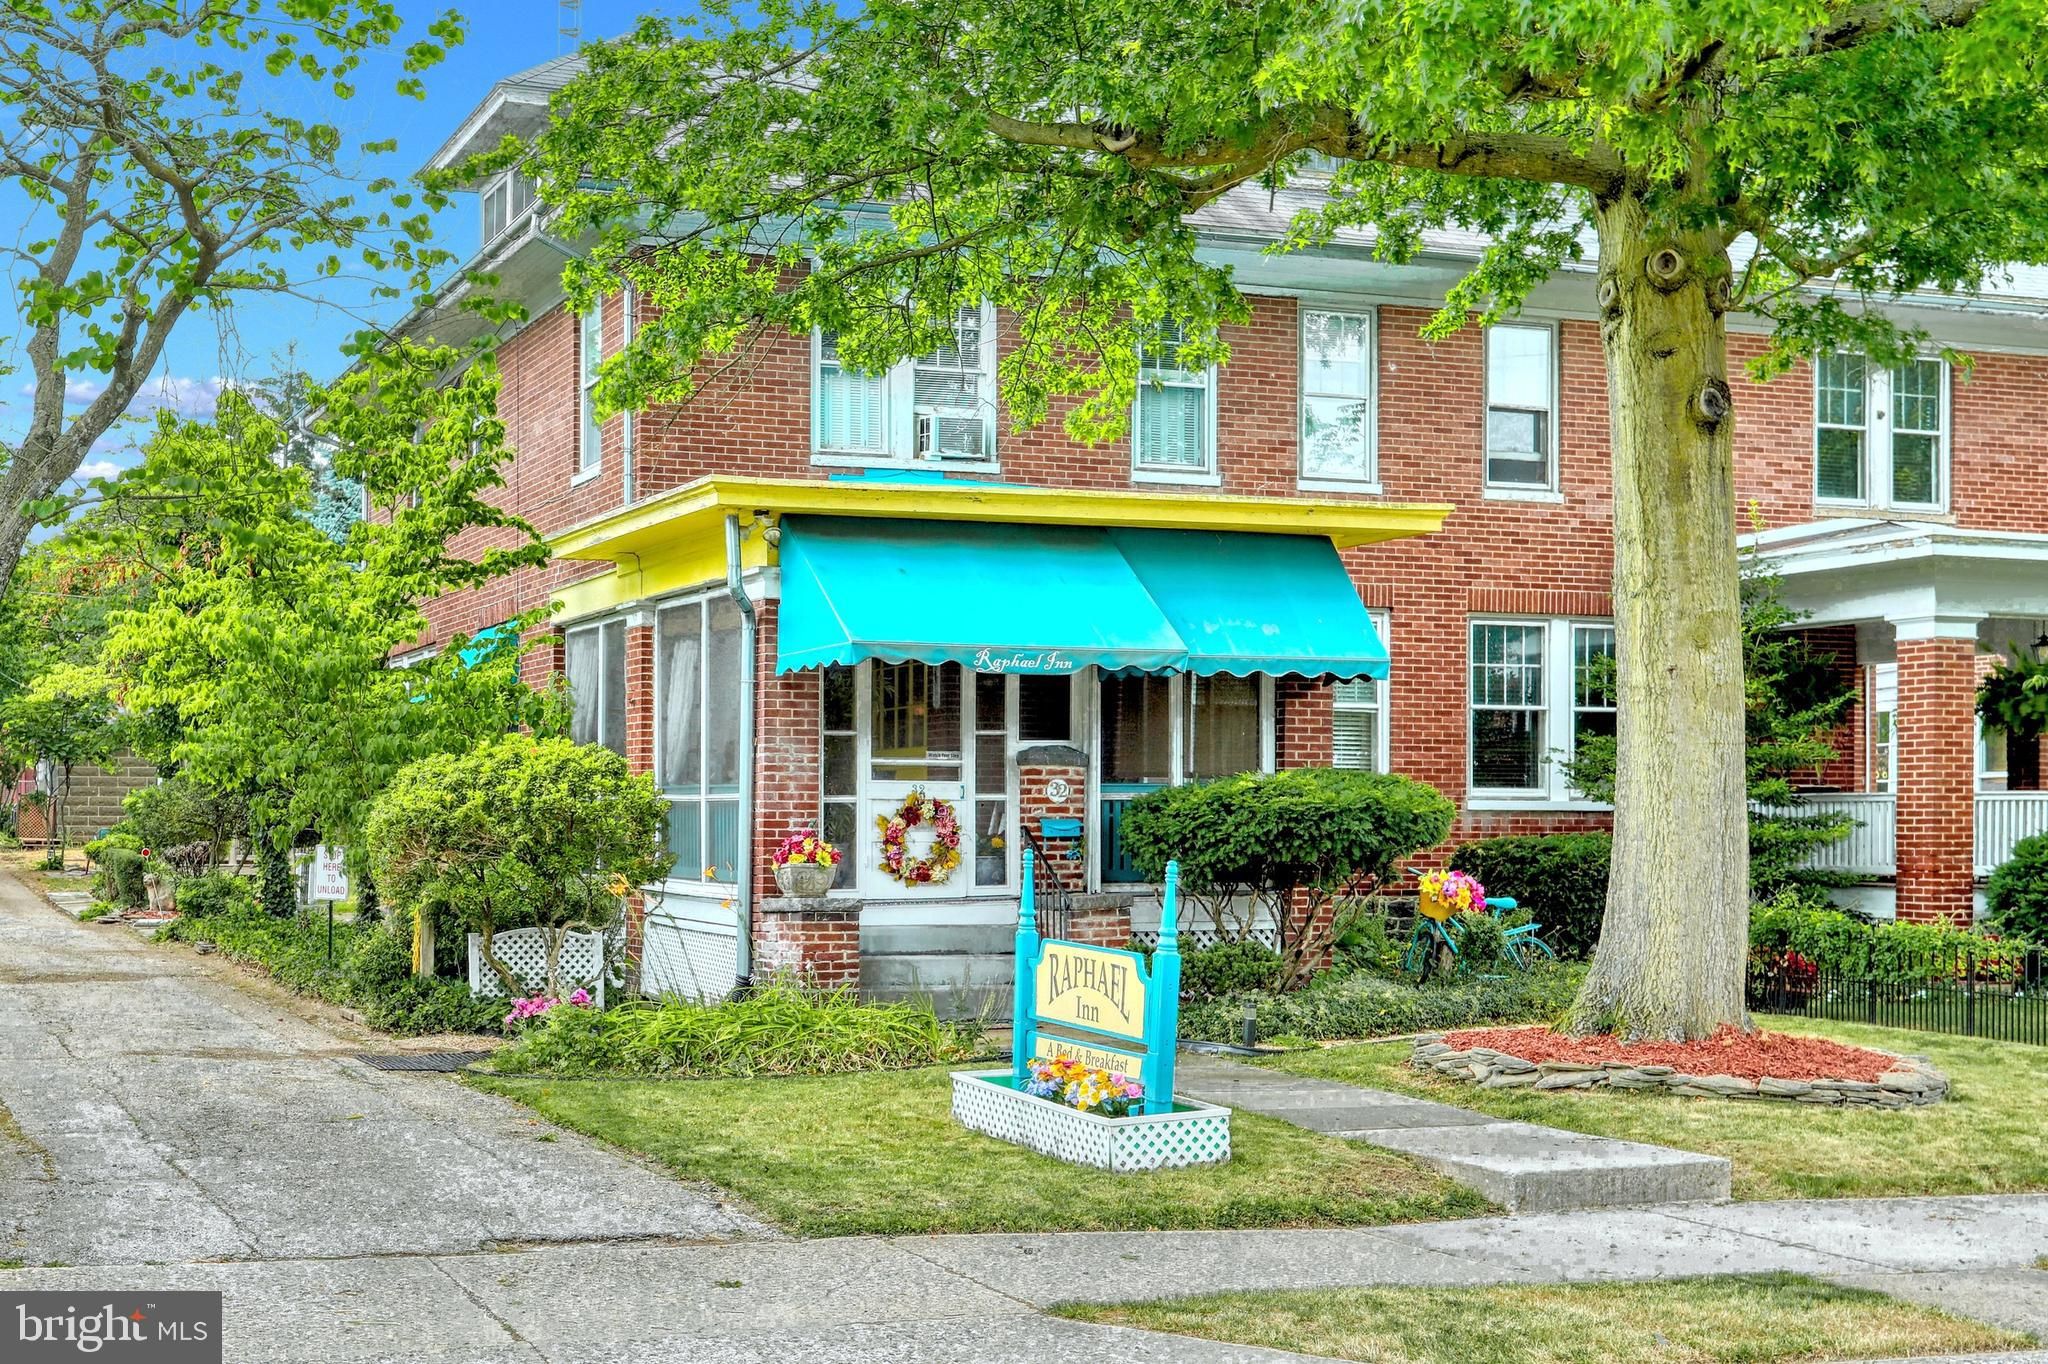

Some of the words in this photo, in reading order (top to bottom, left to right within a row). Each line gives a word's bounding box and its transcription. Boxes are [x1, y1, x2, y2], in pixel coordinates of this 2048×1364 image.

[973, 648, 1044, 672] Raphael
[1043, 650, 1073, 671] Inn
[1050, 781, 1067, 797] 32
[323, 862, 341, 872] HERE
[327, 874, 337, 883] TO
[317, 884, 345, 895] UNLOAD
[1048, 953, 1130, 1024] RAPHAEL
[1076, 995, 1100, 1023] Inn
[1046, 1042, 1054, 1057] A
[1074, 1048, 1083, 1063] &
[1085, 1050, 1128, 1073] Breakfast
